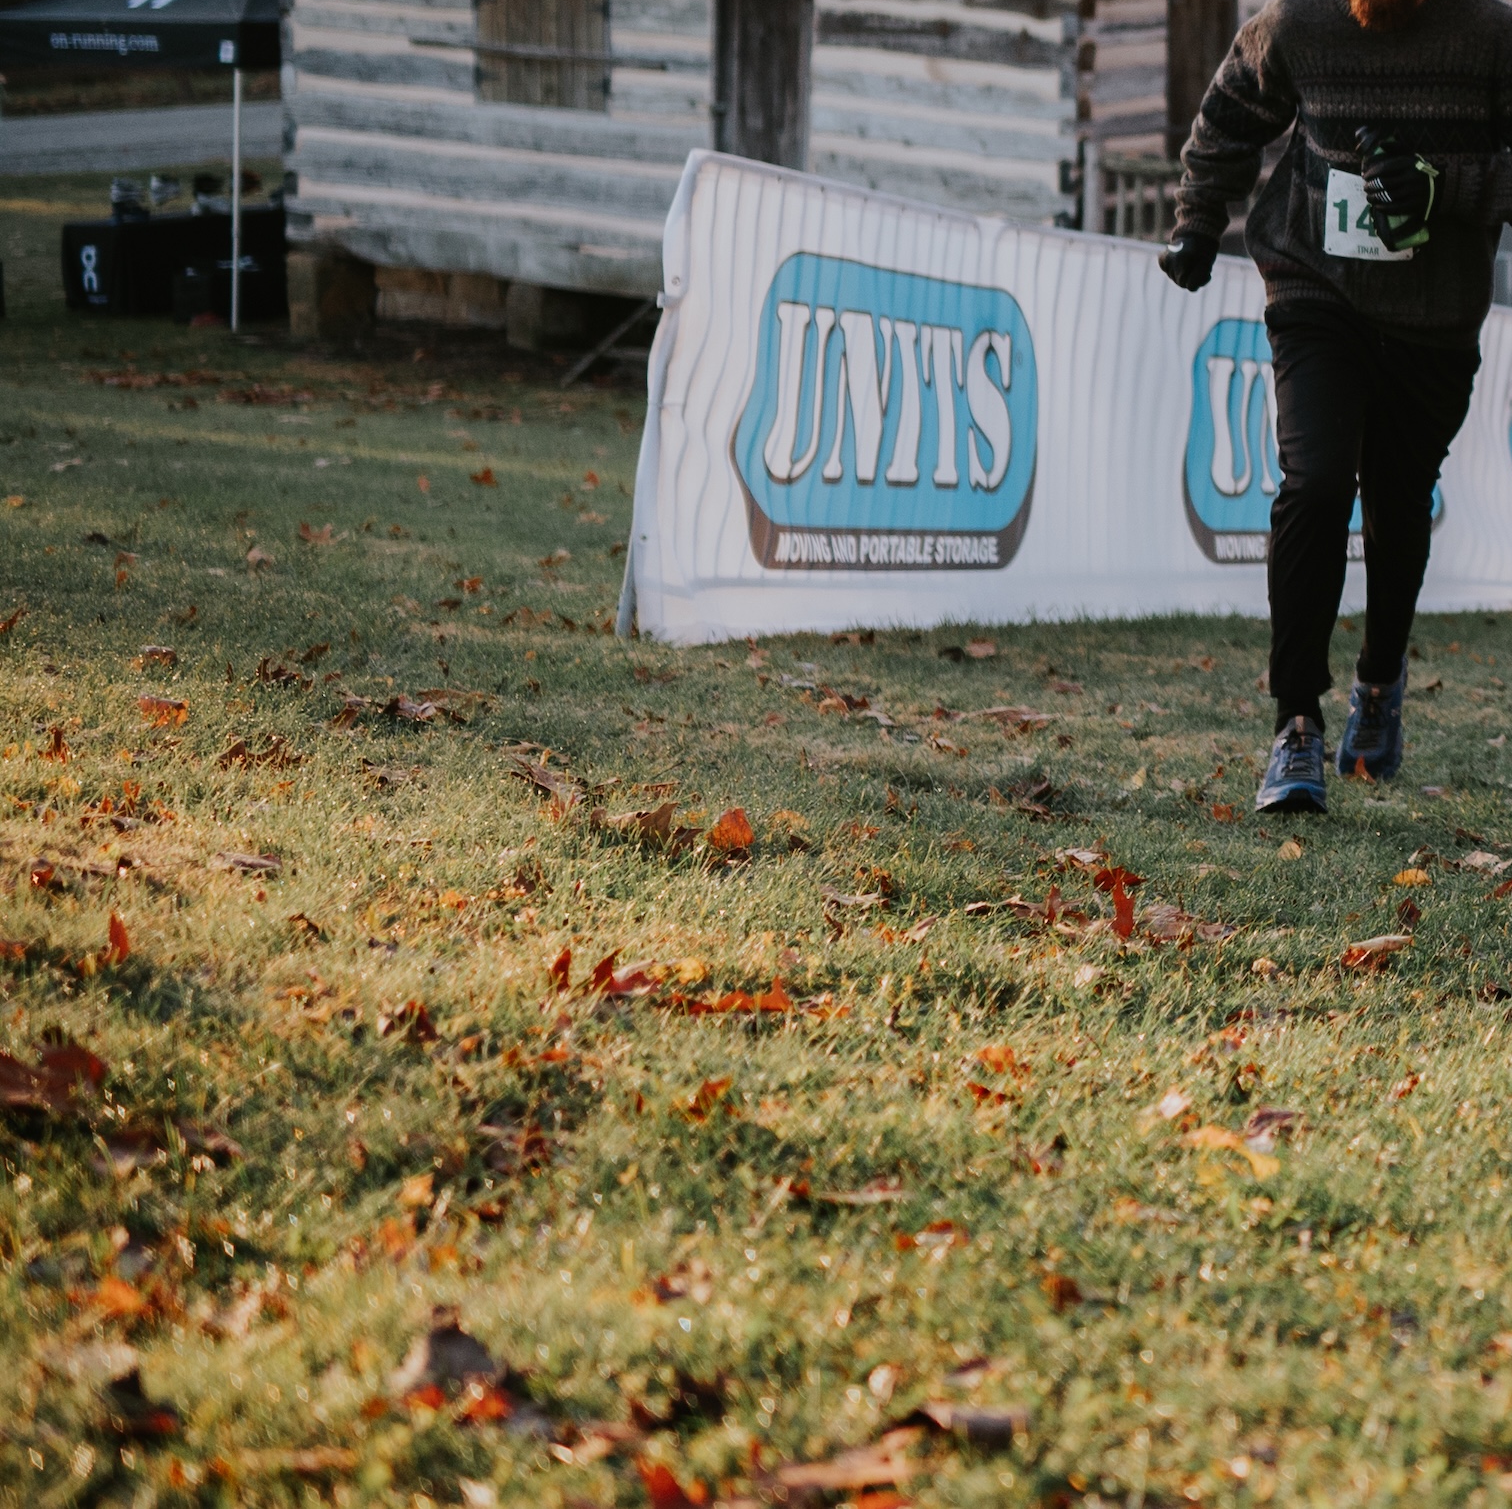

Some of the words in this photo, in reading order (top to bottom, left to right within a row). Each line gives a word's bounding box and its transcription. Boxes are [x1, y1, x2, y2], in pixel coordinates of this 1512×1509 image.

[50, 32, 160, 56] on-running.com
[1333, 199, 1378, 237] 14
[763, 300, 1012, 493] UNITS
[774, 532, 832, 564] MOVING
[830, 534, 858, 564] AND
[860, 535, 934, 564] PORTABLE
[934, 536, 999, 564] STORAGE
